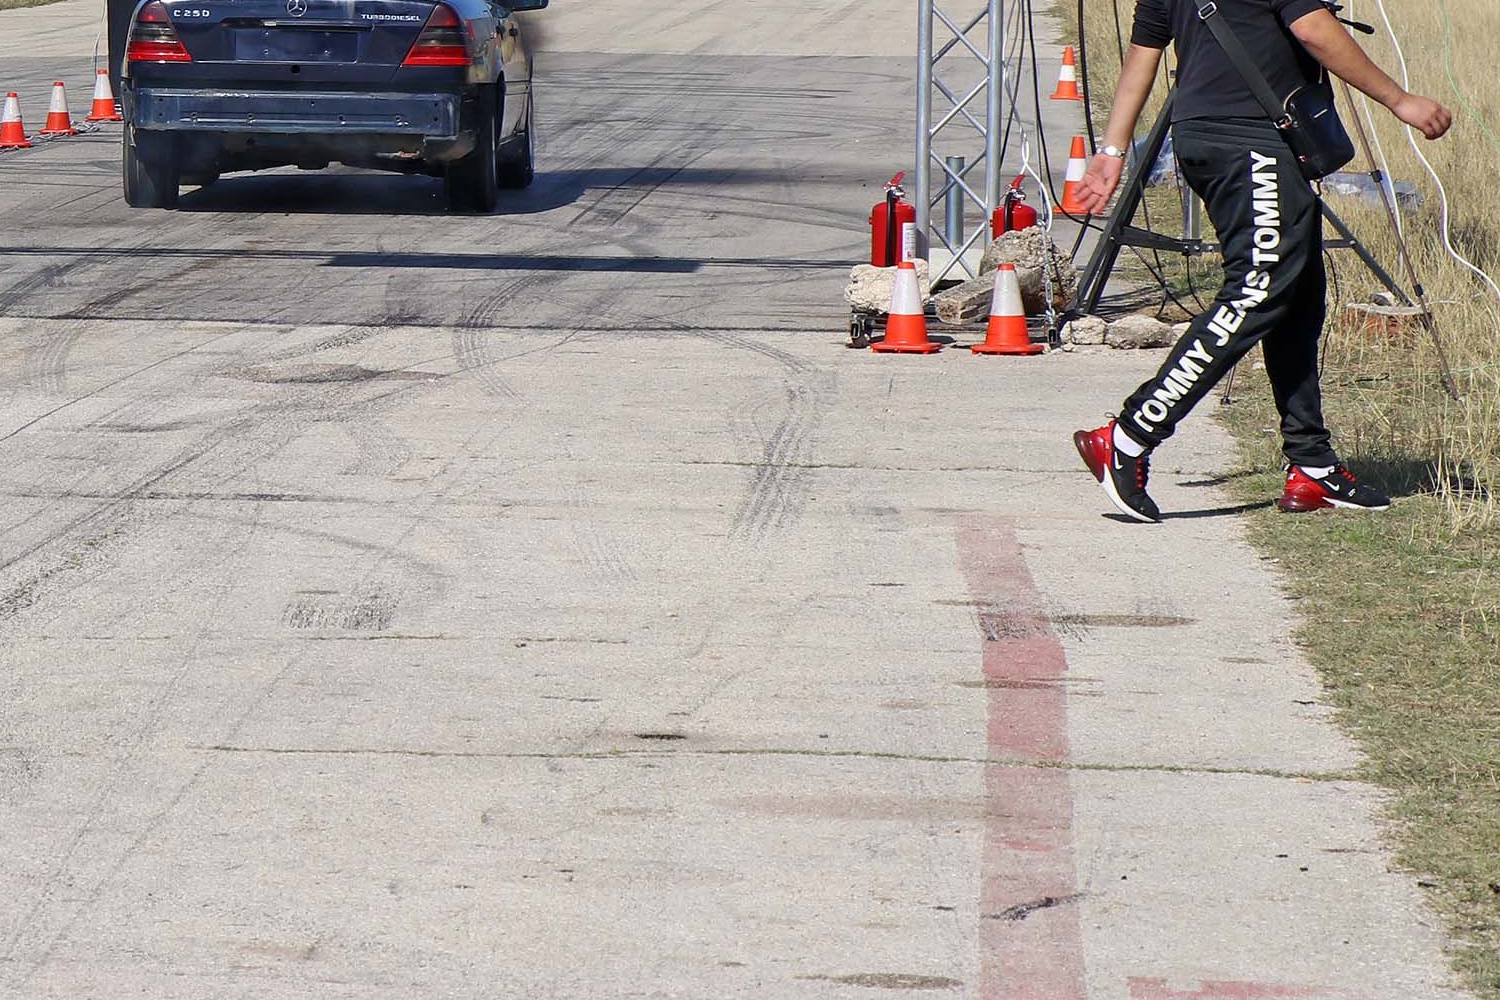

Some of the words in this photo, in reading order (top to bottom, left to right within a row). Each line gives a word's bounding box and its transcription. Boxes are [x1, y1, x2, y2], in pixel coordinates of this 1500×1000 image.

[1133, 339, 1214, 432] TOMMY
[1206, 270, 1271, 347] JEANS
[1249, 150, 1281, 264] TOMMY
